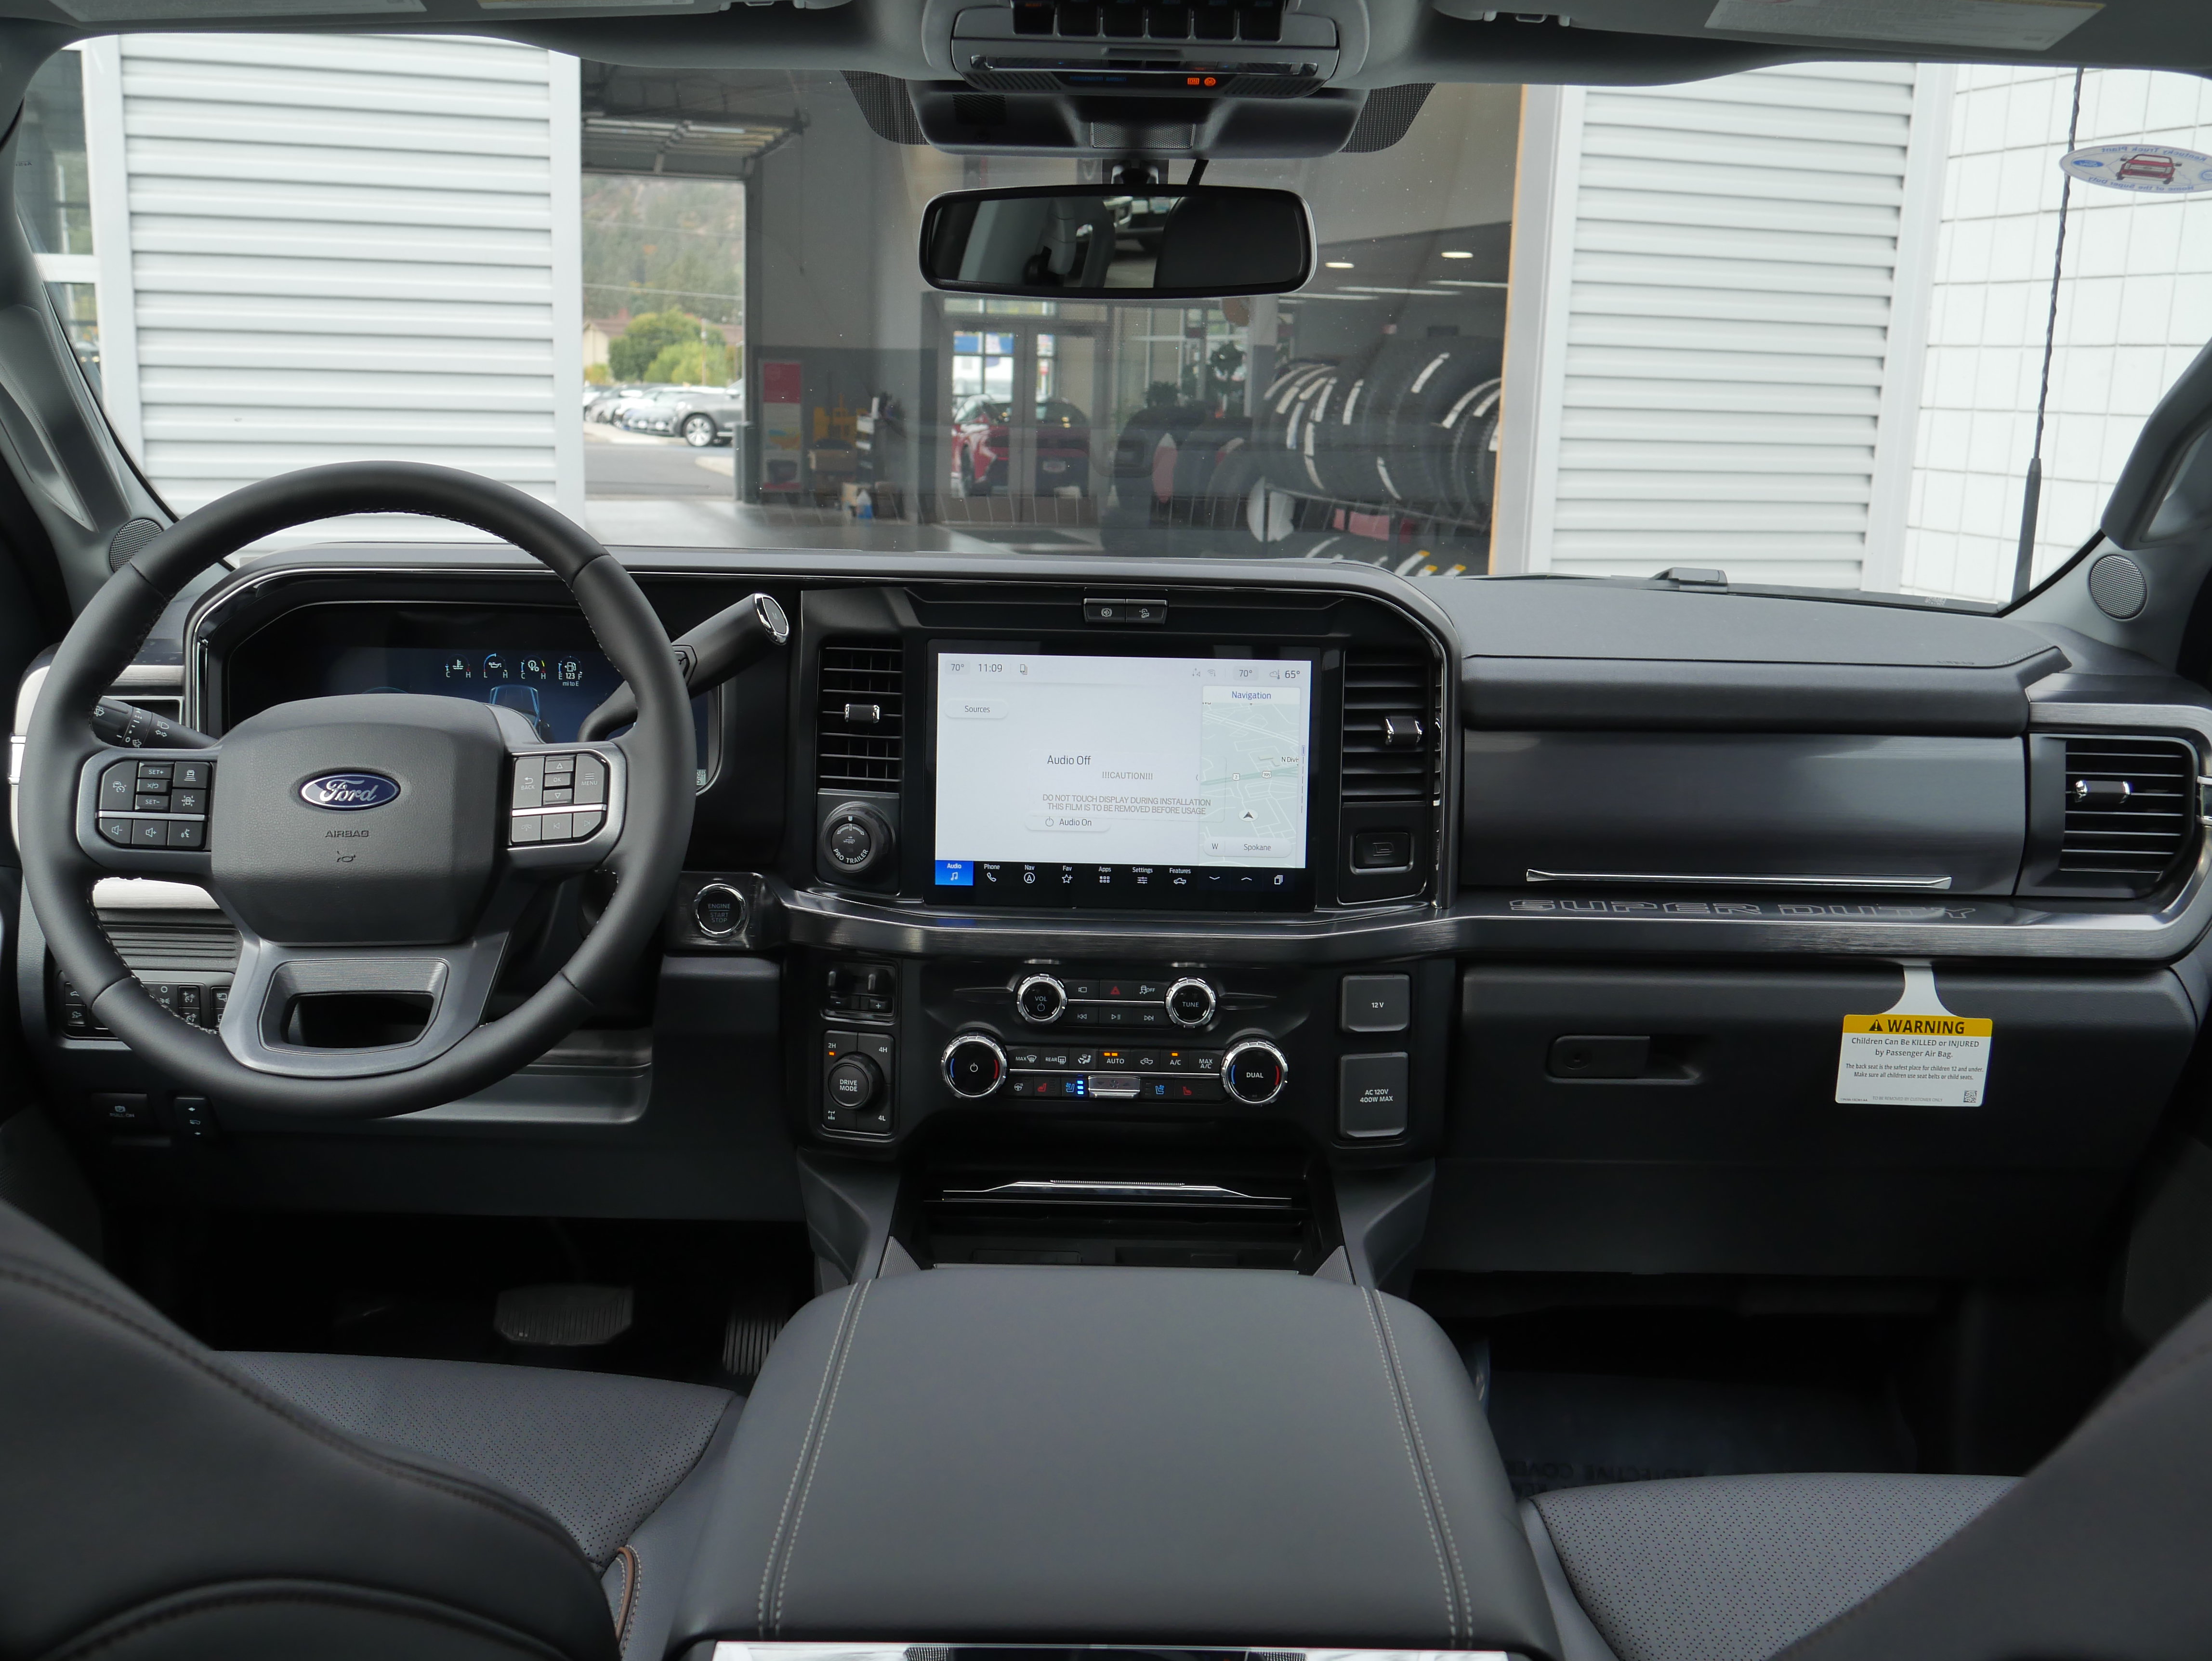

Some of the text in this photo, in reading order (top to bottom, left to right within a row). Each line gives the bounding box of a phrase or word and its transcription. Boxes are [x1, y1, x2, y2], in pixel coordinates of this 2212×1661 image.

[978, 663, 1003, 672] 11:09
[1239, 669, 1252, 677] 70°
[1285, 670, 1300, 679] 65°
[1232, 691, 1271, 700] Navigation
[1047, 755, 1091, 765] Audio Off
[319, 779, 379, 802] Ford
[1130, 797, 1159, 805] DURING
[1160, 798, 1211, 806] INSTALLATION
[1114, 805, 1150, 813] REMOVED
[833, 848, 869, 864] PRO TRAILER
[1509, 899, 1975, 919] SUPER DUTY
[1888, 1019, 1965, 1034] WARNING
[1875, 1049, 1884, 1057] by
[1886, 1050, 1923, 1058] Passenger
